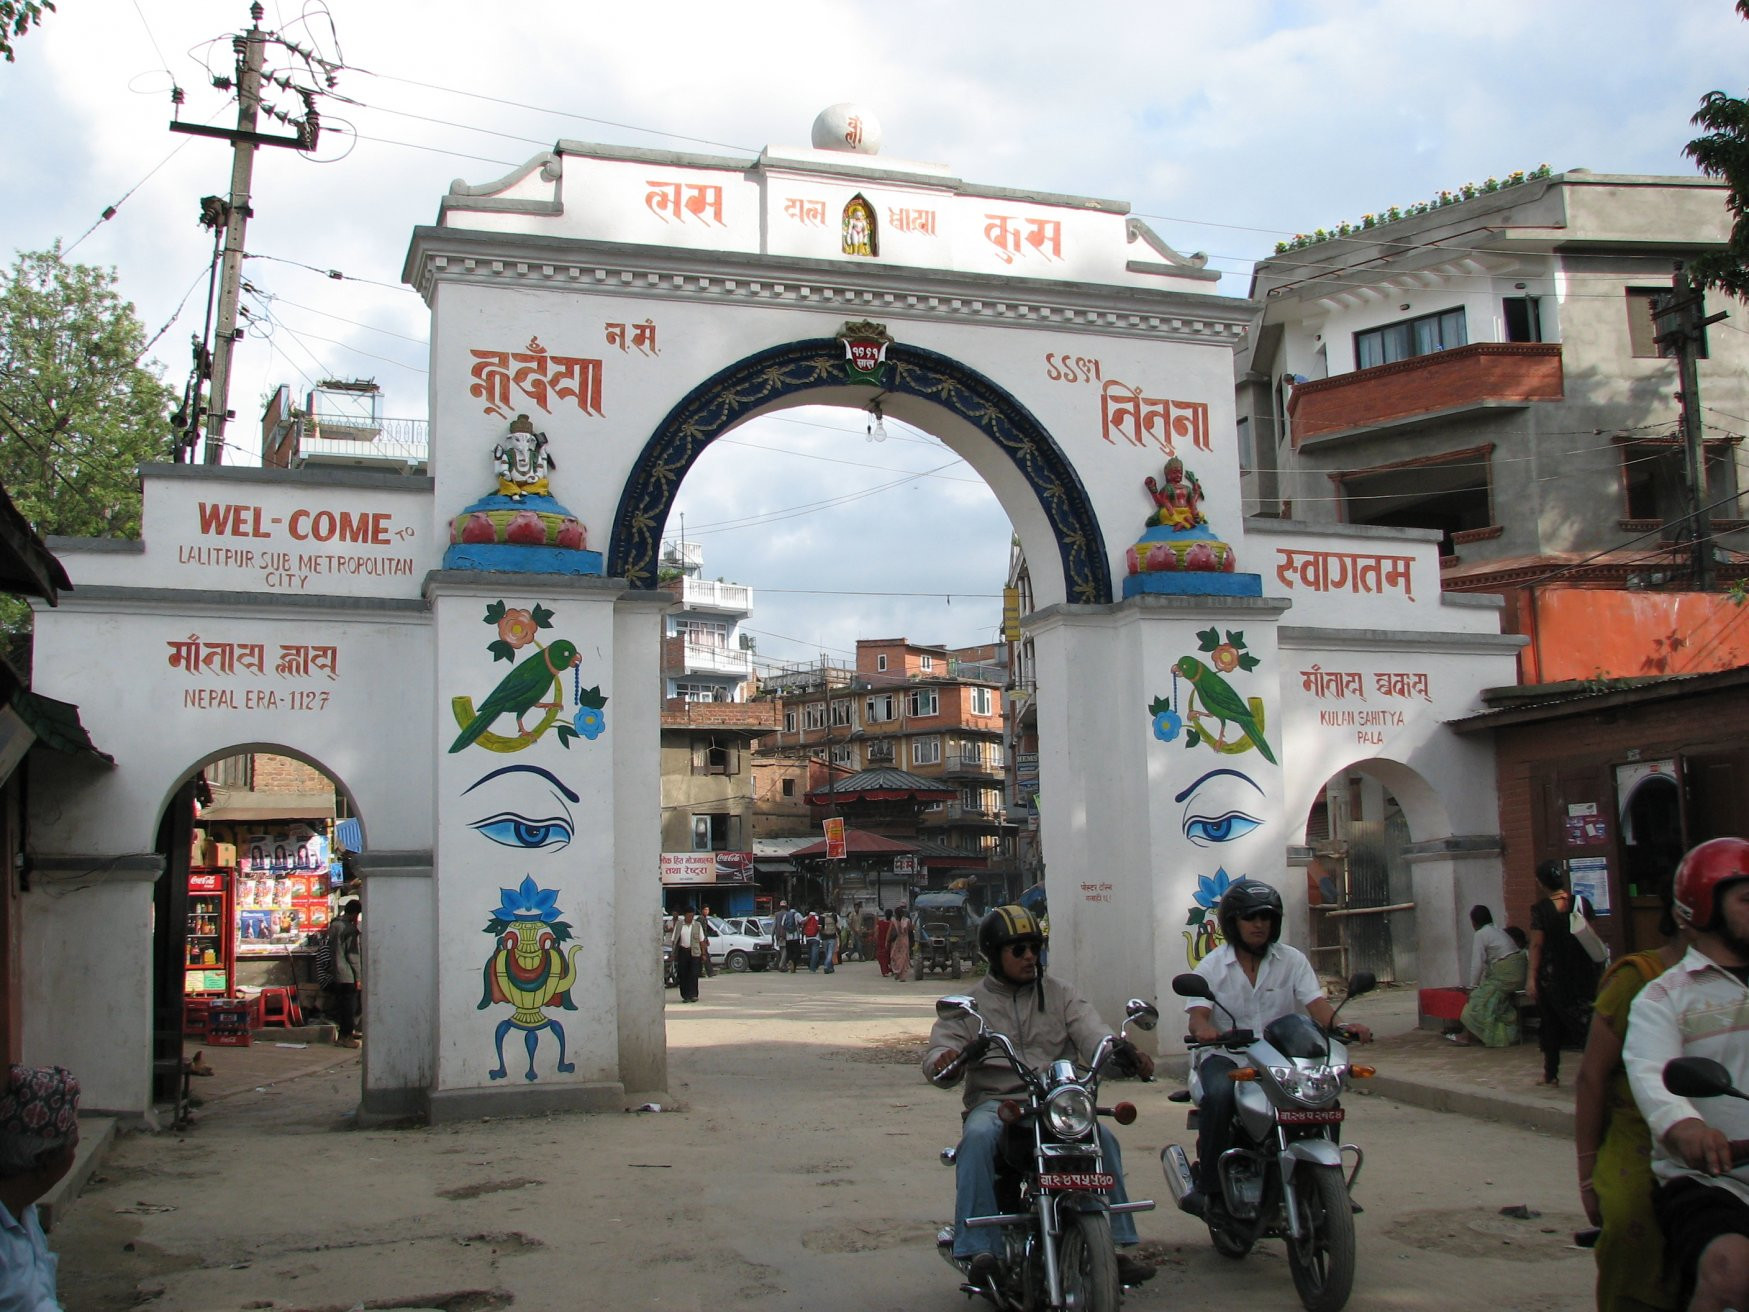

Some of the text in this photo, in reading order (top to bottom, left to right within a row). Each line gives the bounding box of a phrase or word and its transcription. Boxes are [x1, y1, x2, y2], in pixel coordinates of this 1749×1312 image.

[198, 502, 415, 545] WEL-COME TO
[179, 545, 413, 577] LALITPUR SUB METROPOLITAN
[266, 572, 308, 589] CITY
[1276, 548, 1416, 602] स्वागतम्
[184, 689, 238, 710] NEPAL
[1358, 710, 1405, 727] SAHITYA
[1357, 731, 1384, 745] PALA
